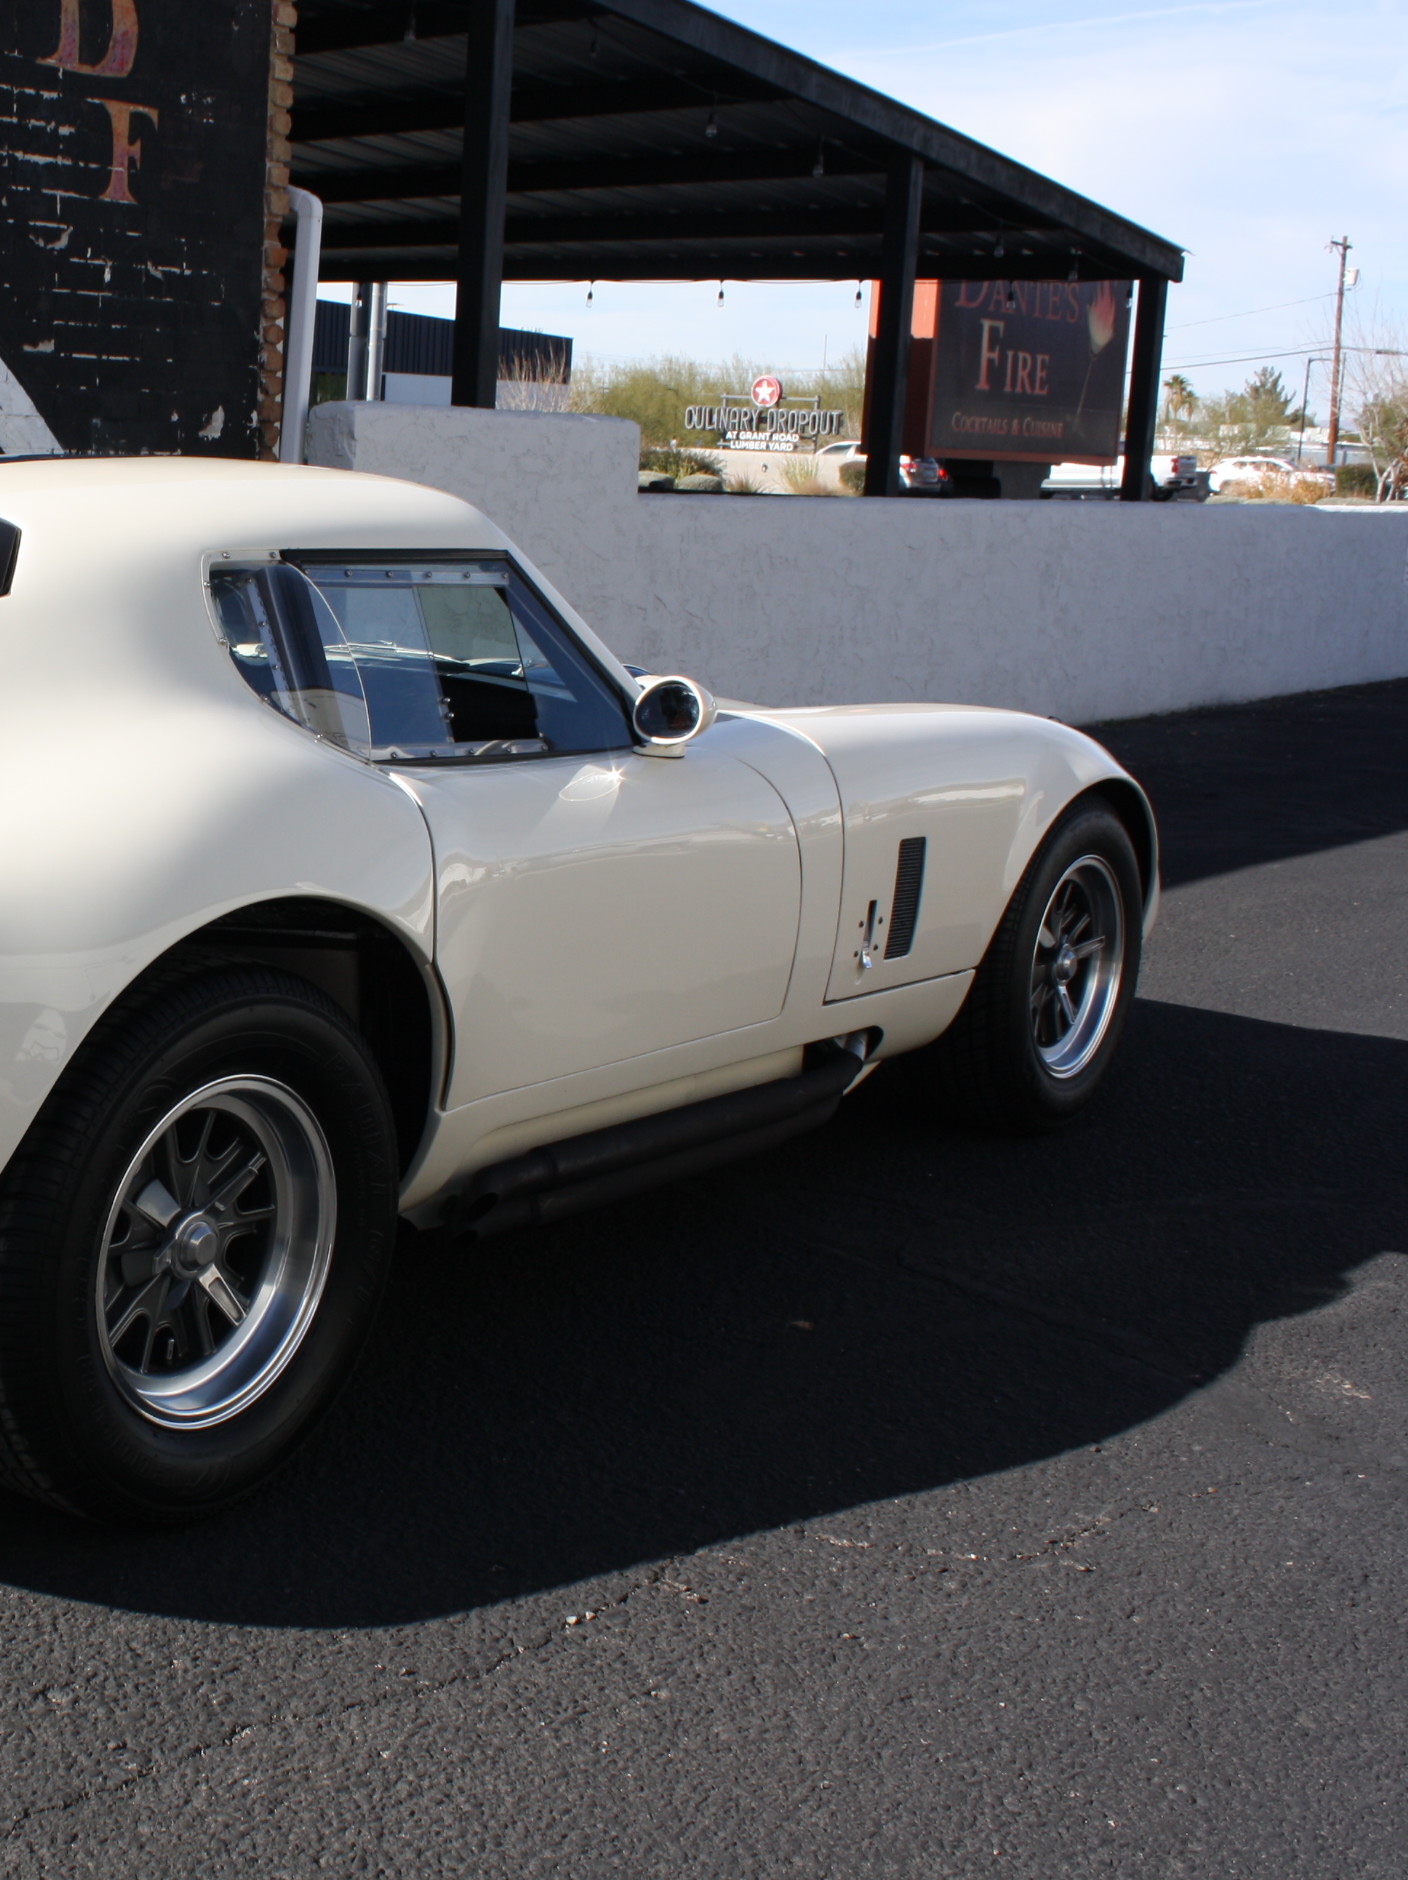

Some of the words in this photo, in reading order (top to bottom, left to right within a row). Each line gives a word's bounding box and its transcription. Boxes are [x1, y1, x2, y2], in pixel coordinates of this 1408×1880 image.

[35, 0, 140, 78] D
[83, 97, 160, 205] F
[975, 317, 1051, 396] FIRE
[684, 405, 761, 432] CULINARY
[766, 408, 843, 435] DROPOUT
[951, 411, 1008, 435] COCKTAILS
[1011, 418, 1020, 436] &
[1022, 416, 1065, 439] CUISINE
[725, 431, 738, 440] AT
[739, 431, 771, 441] GRANT
[772, 432, 800, 442] ROAD
[729, 440, 767, 451] LUMBER
[768, 442, 794, 452] YARD
